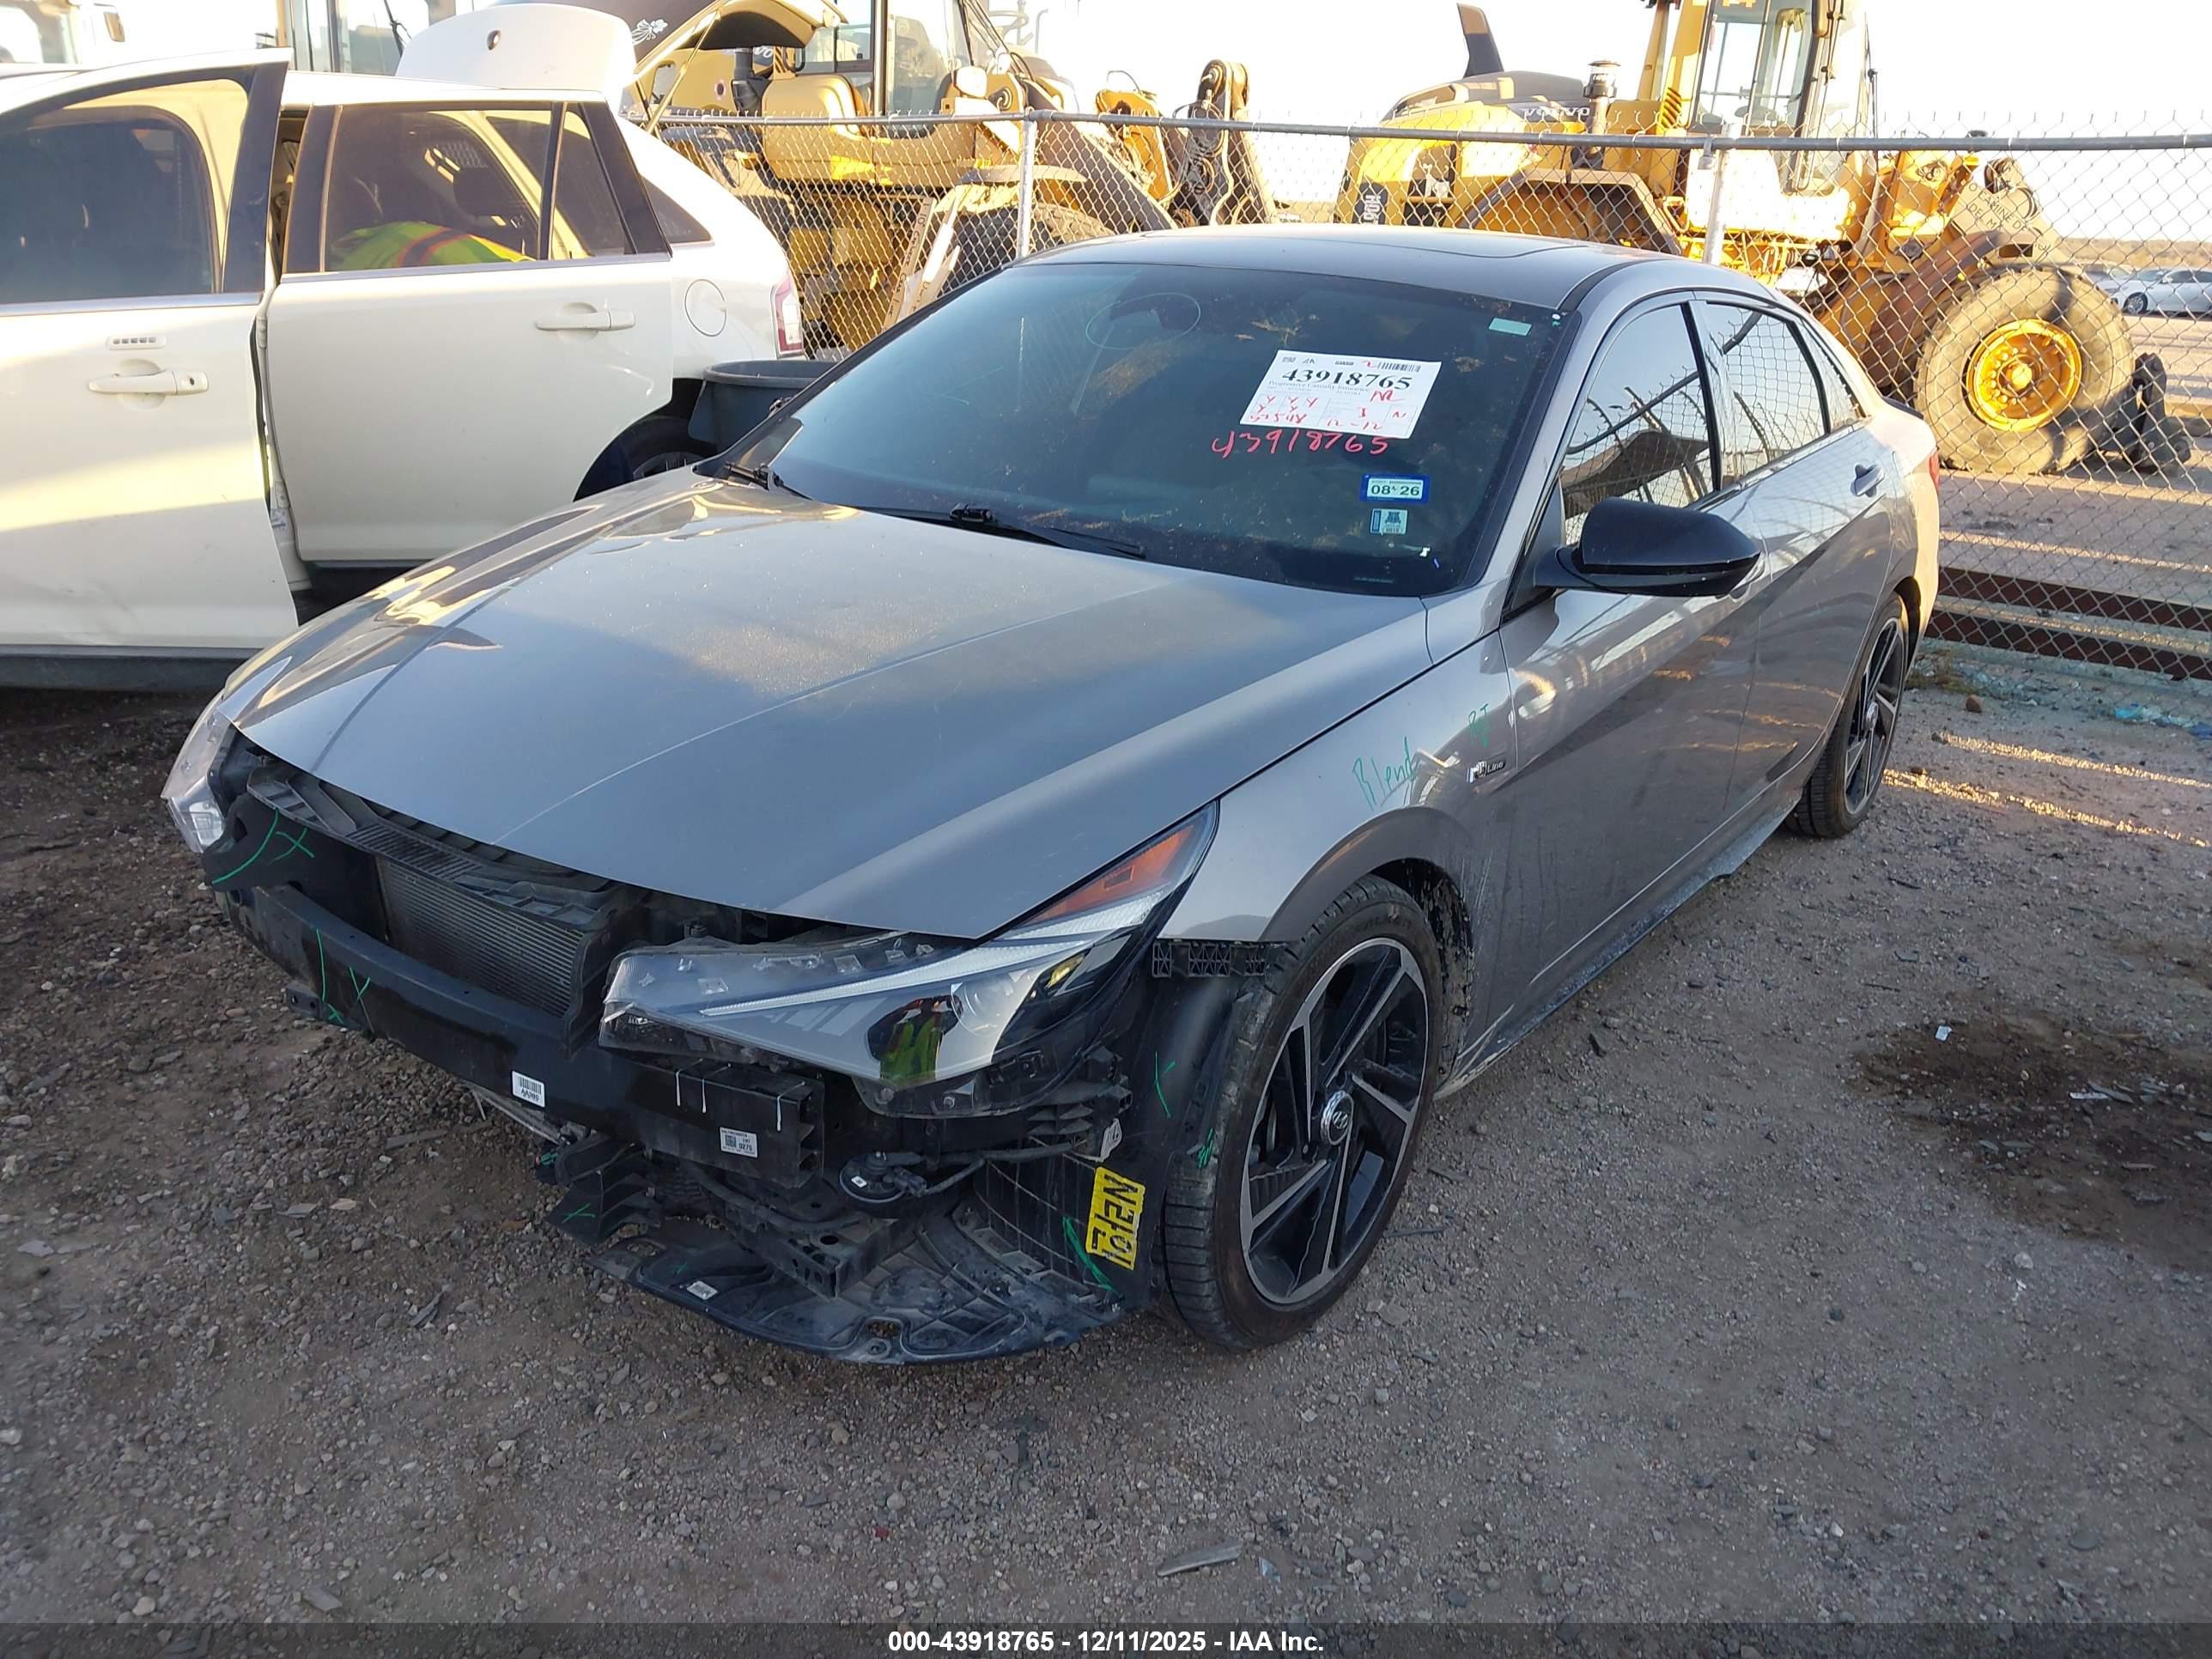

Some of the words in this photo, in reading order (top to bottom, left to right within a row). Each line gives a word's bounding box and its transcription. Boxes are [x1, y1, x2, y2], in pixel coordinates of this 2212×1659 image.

[1281, 368, 1413, 391] 43918765
[1211, 429, 1389, 459] 43918765
[1370, 484, 1391, 495] 08
[1399, 485, 1420, 496] 26
